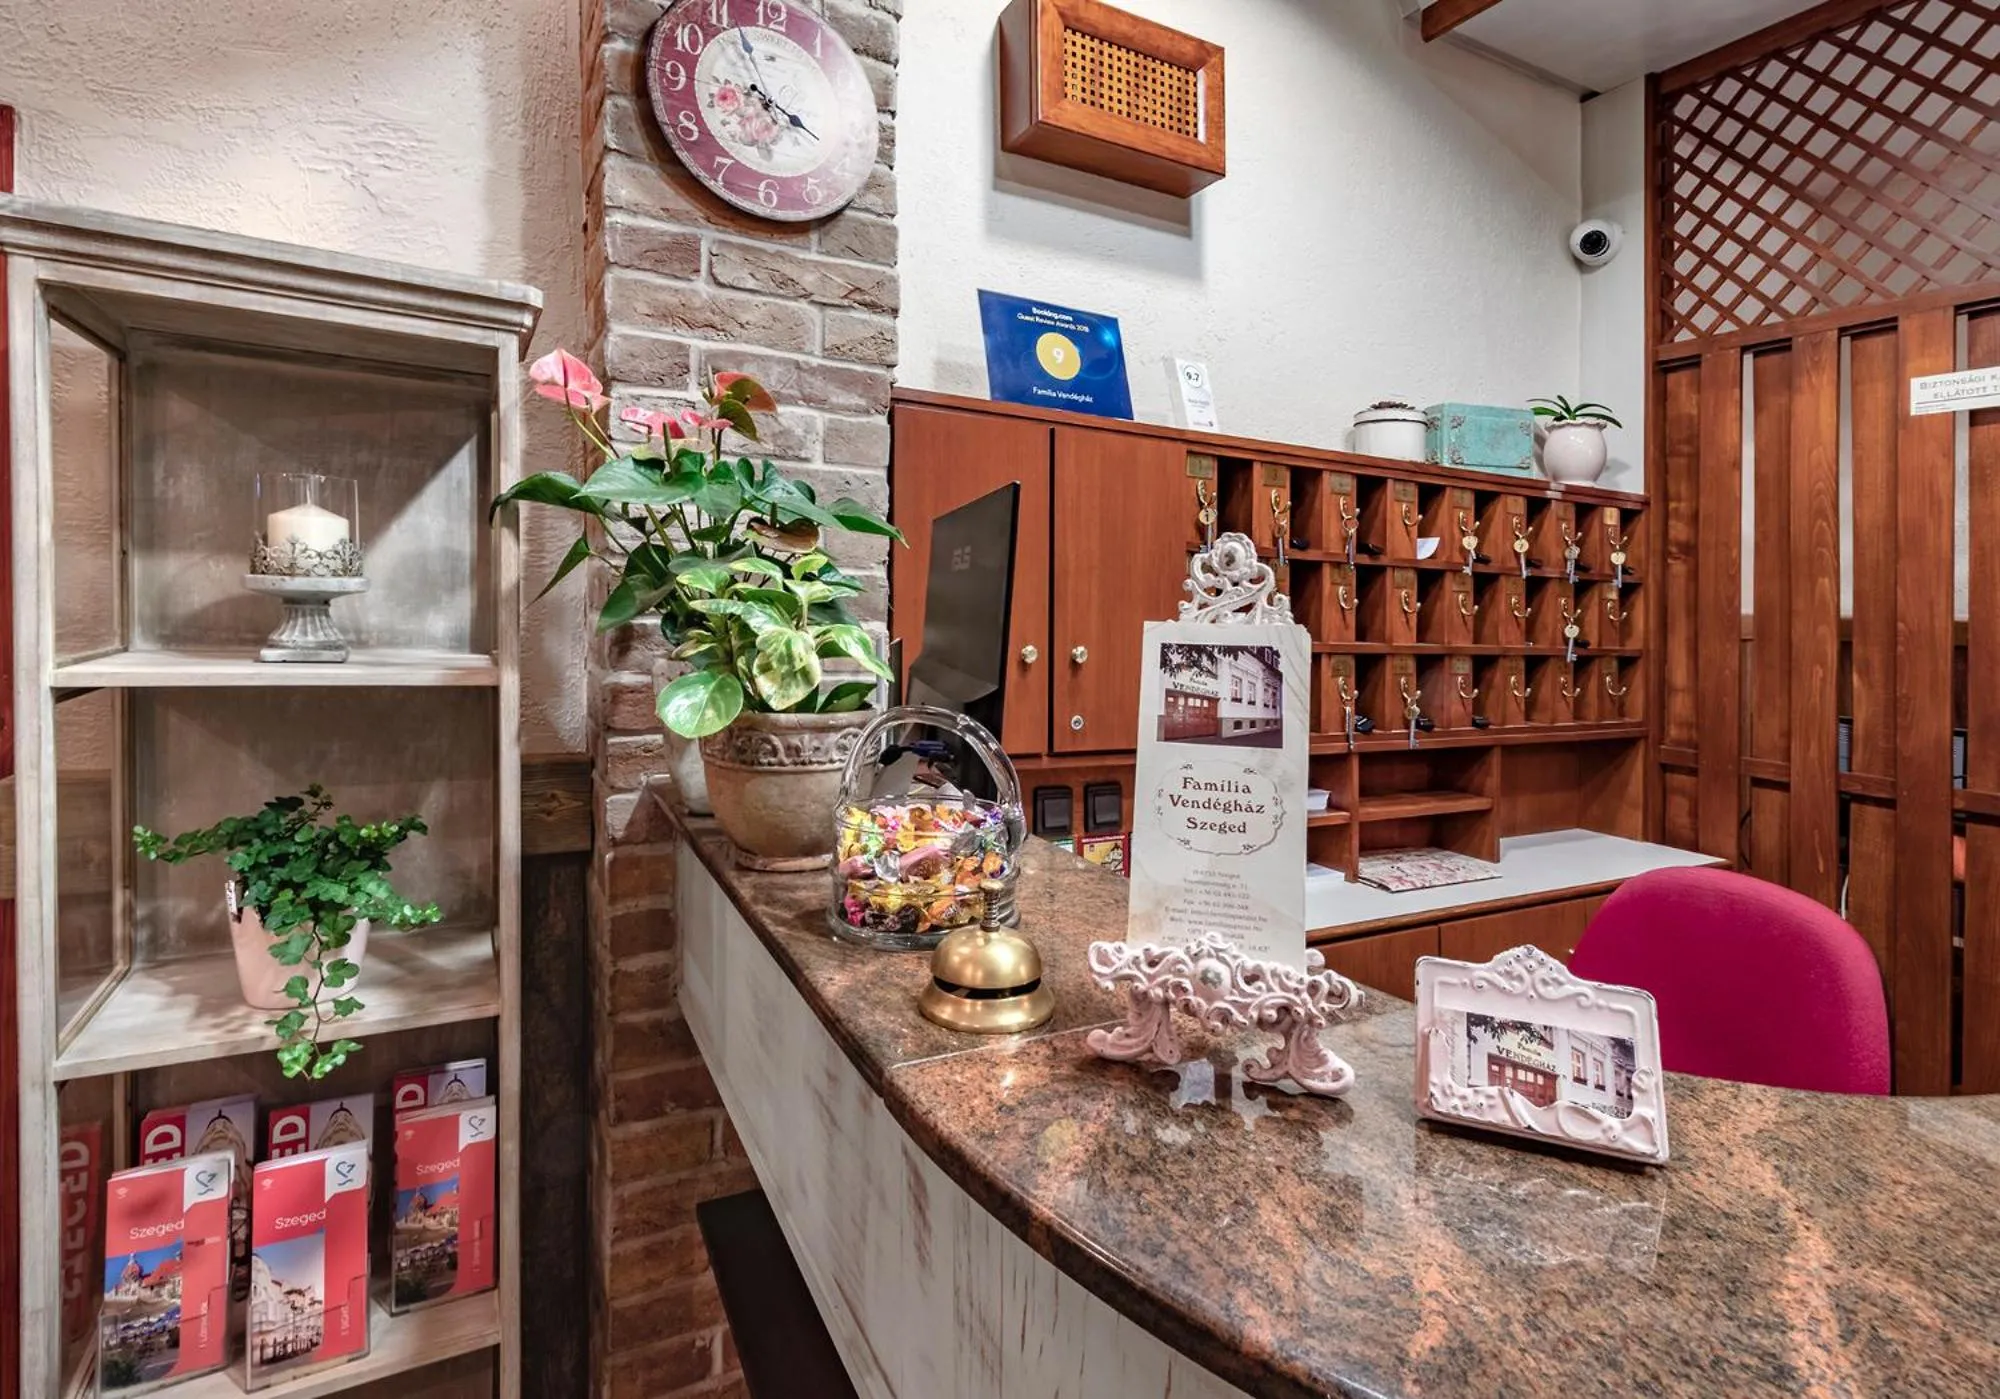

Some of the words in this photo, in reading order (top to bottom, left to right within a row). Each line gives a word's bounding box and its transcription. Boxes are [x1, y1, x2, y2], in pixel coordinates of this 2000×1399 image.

[707, 0, 730, 28] 11
[755, 0, 788, 32] 12
[674, 23, 703, 55] 10
[812, 28, 823, 58] 1
[664, 60, 686, 91] 9
[677, 110, 699, 141] 8
[713, 156, 735, 185] 7
[758, 179, 780, 208] 6
[802, 178, 822, 204] 5
[1053, 347, 1065, 364] 9
[1169, 793, 1265, 814] Vendégház
[1186, 816, 1247, 834] Szeged
[416, 1156, 461, 1176] Szeged
[129, 1218, 185, 1240] Szeged
[274, 1208, 327, 1230] Szeged
